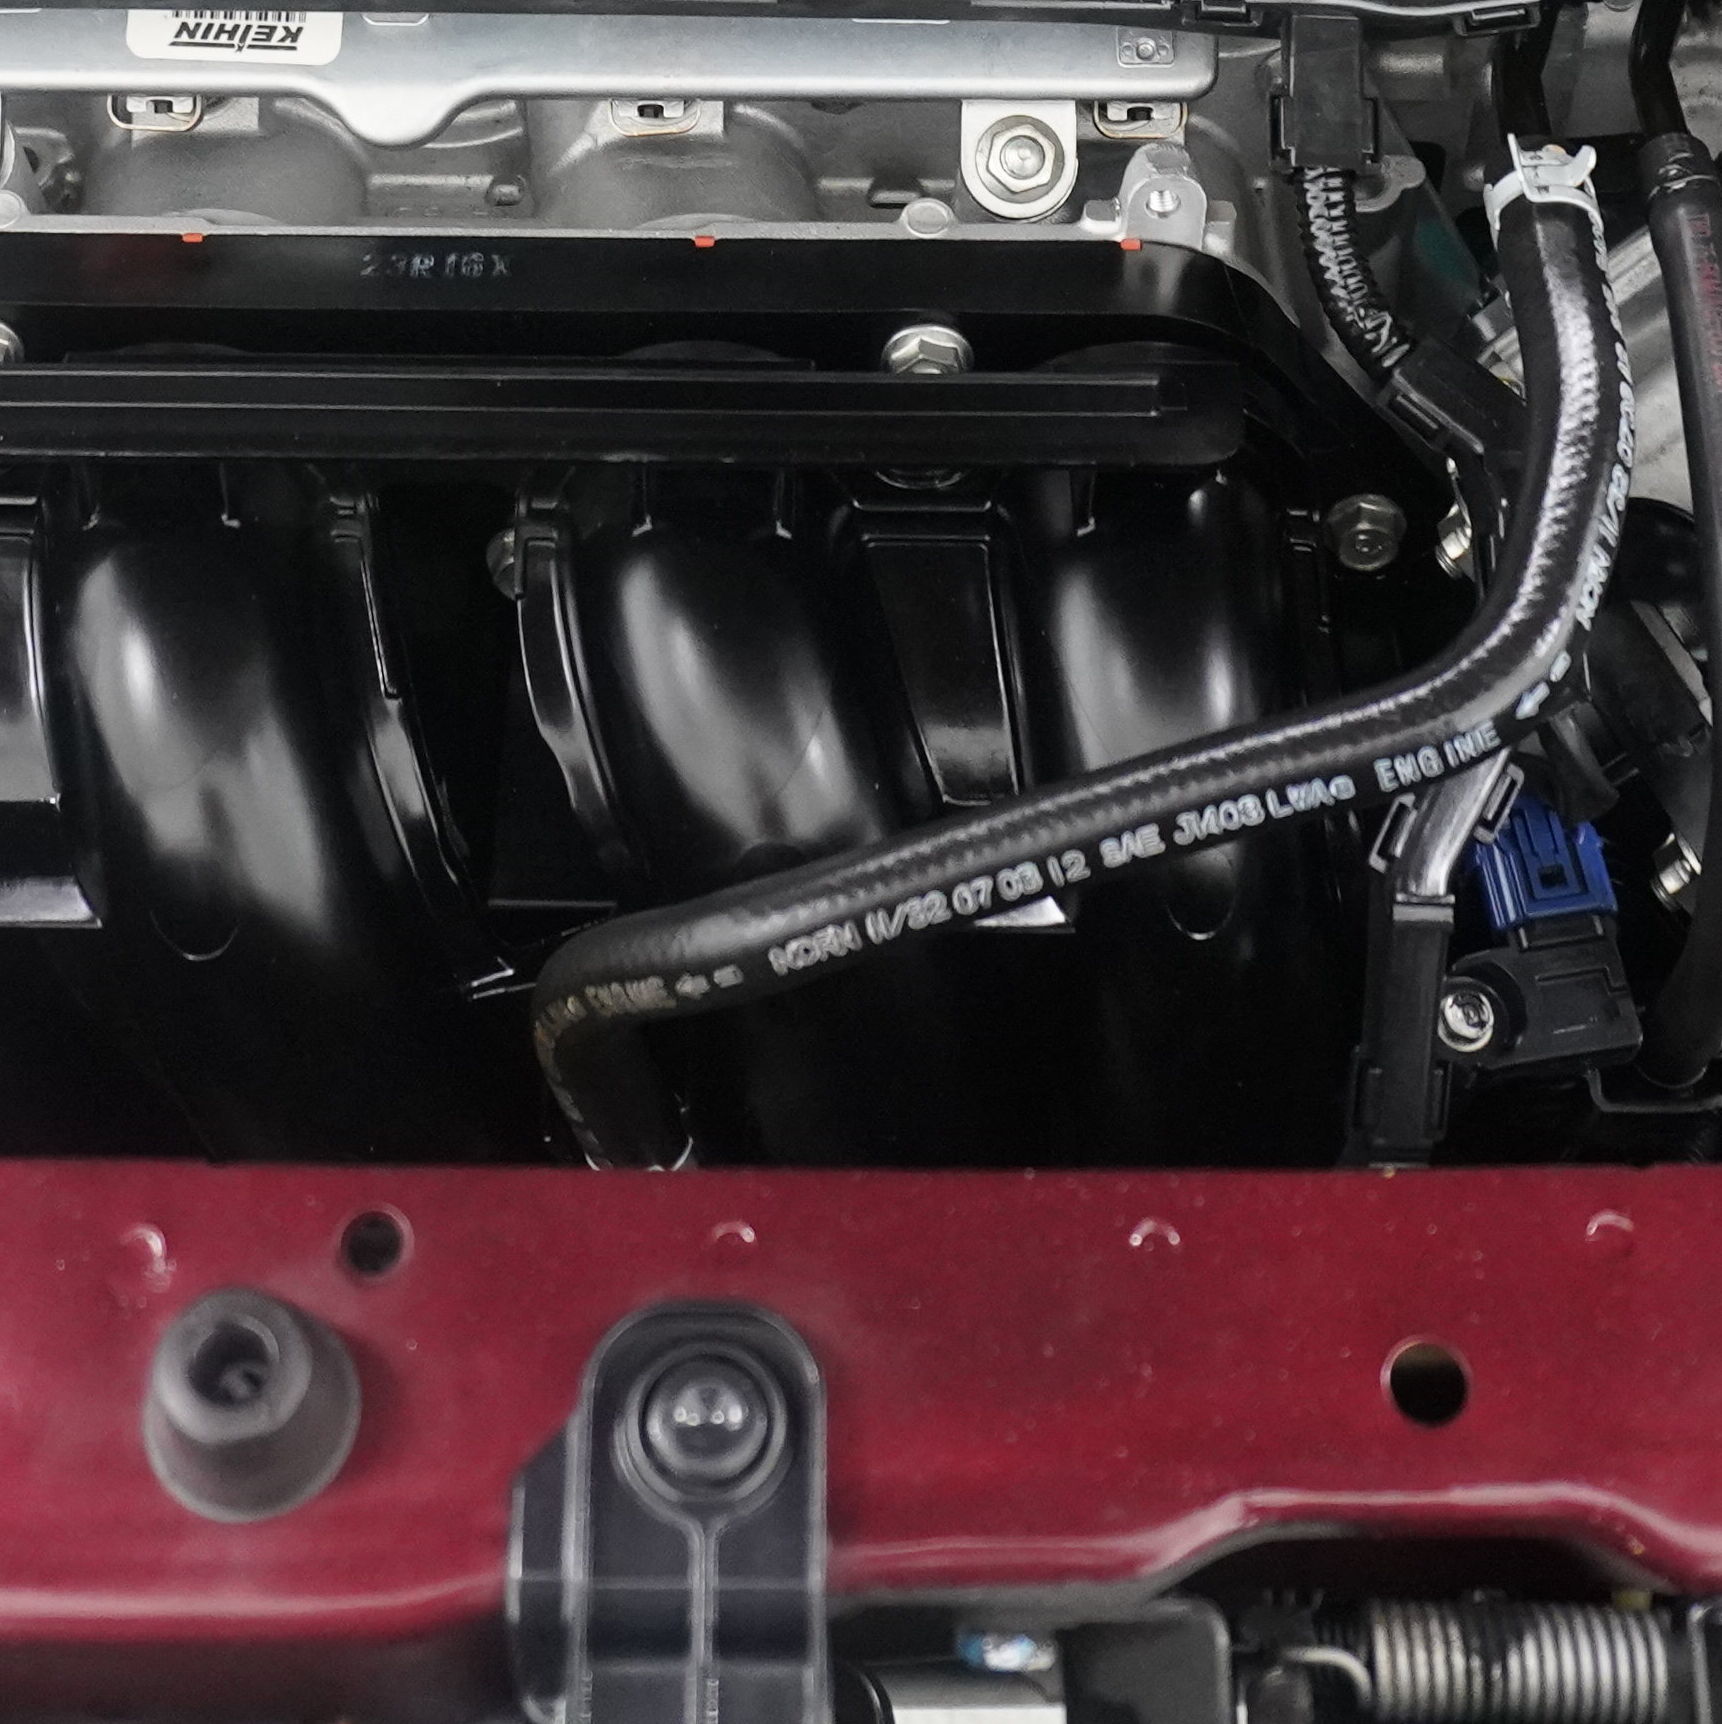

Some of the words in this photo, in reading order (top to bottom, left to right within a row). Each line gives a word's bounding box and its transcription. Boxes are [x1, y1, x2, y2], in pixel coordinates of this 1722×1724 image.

[173, 21, 304, 53] KEIHIN
[951, 875, 994, 916] 07
[1099, 822, 1166, 869] SAE
[1373, 720, 1503, 794] ENGINE
